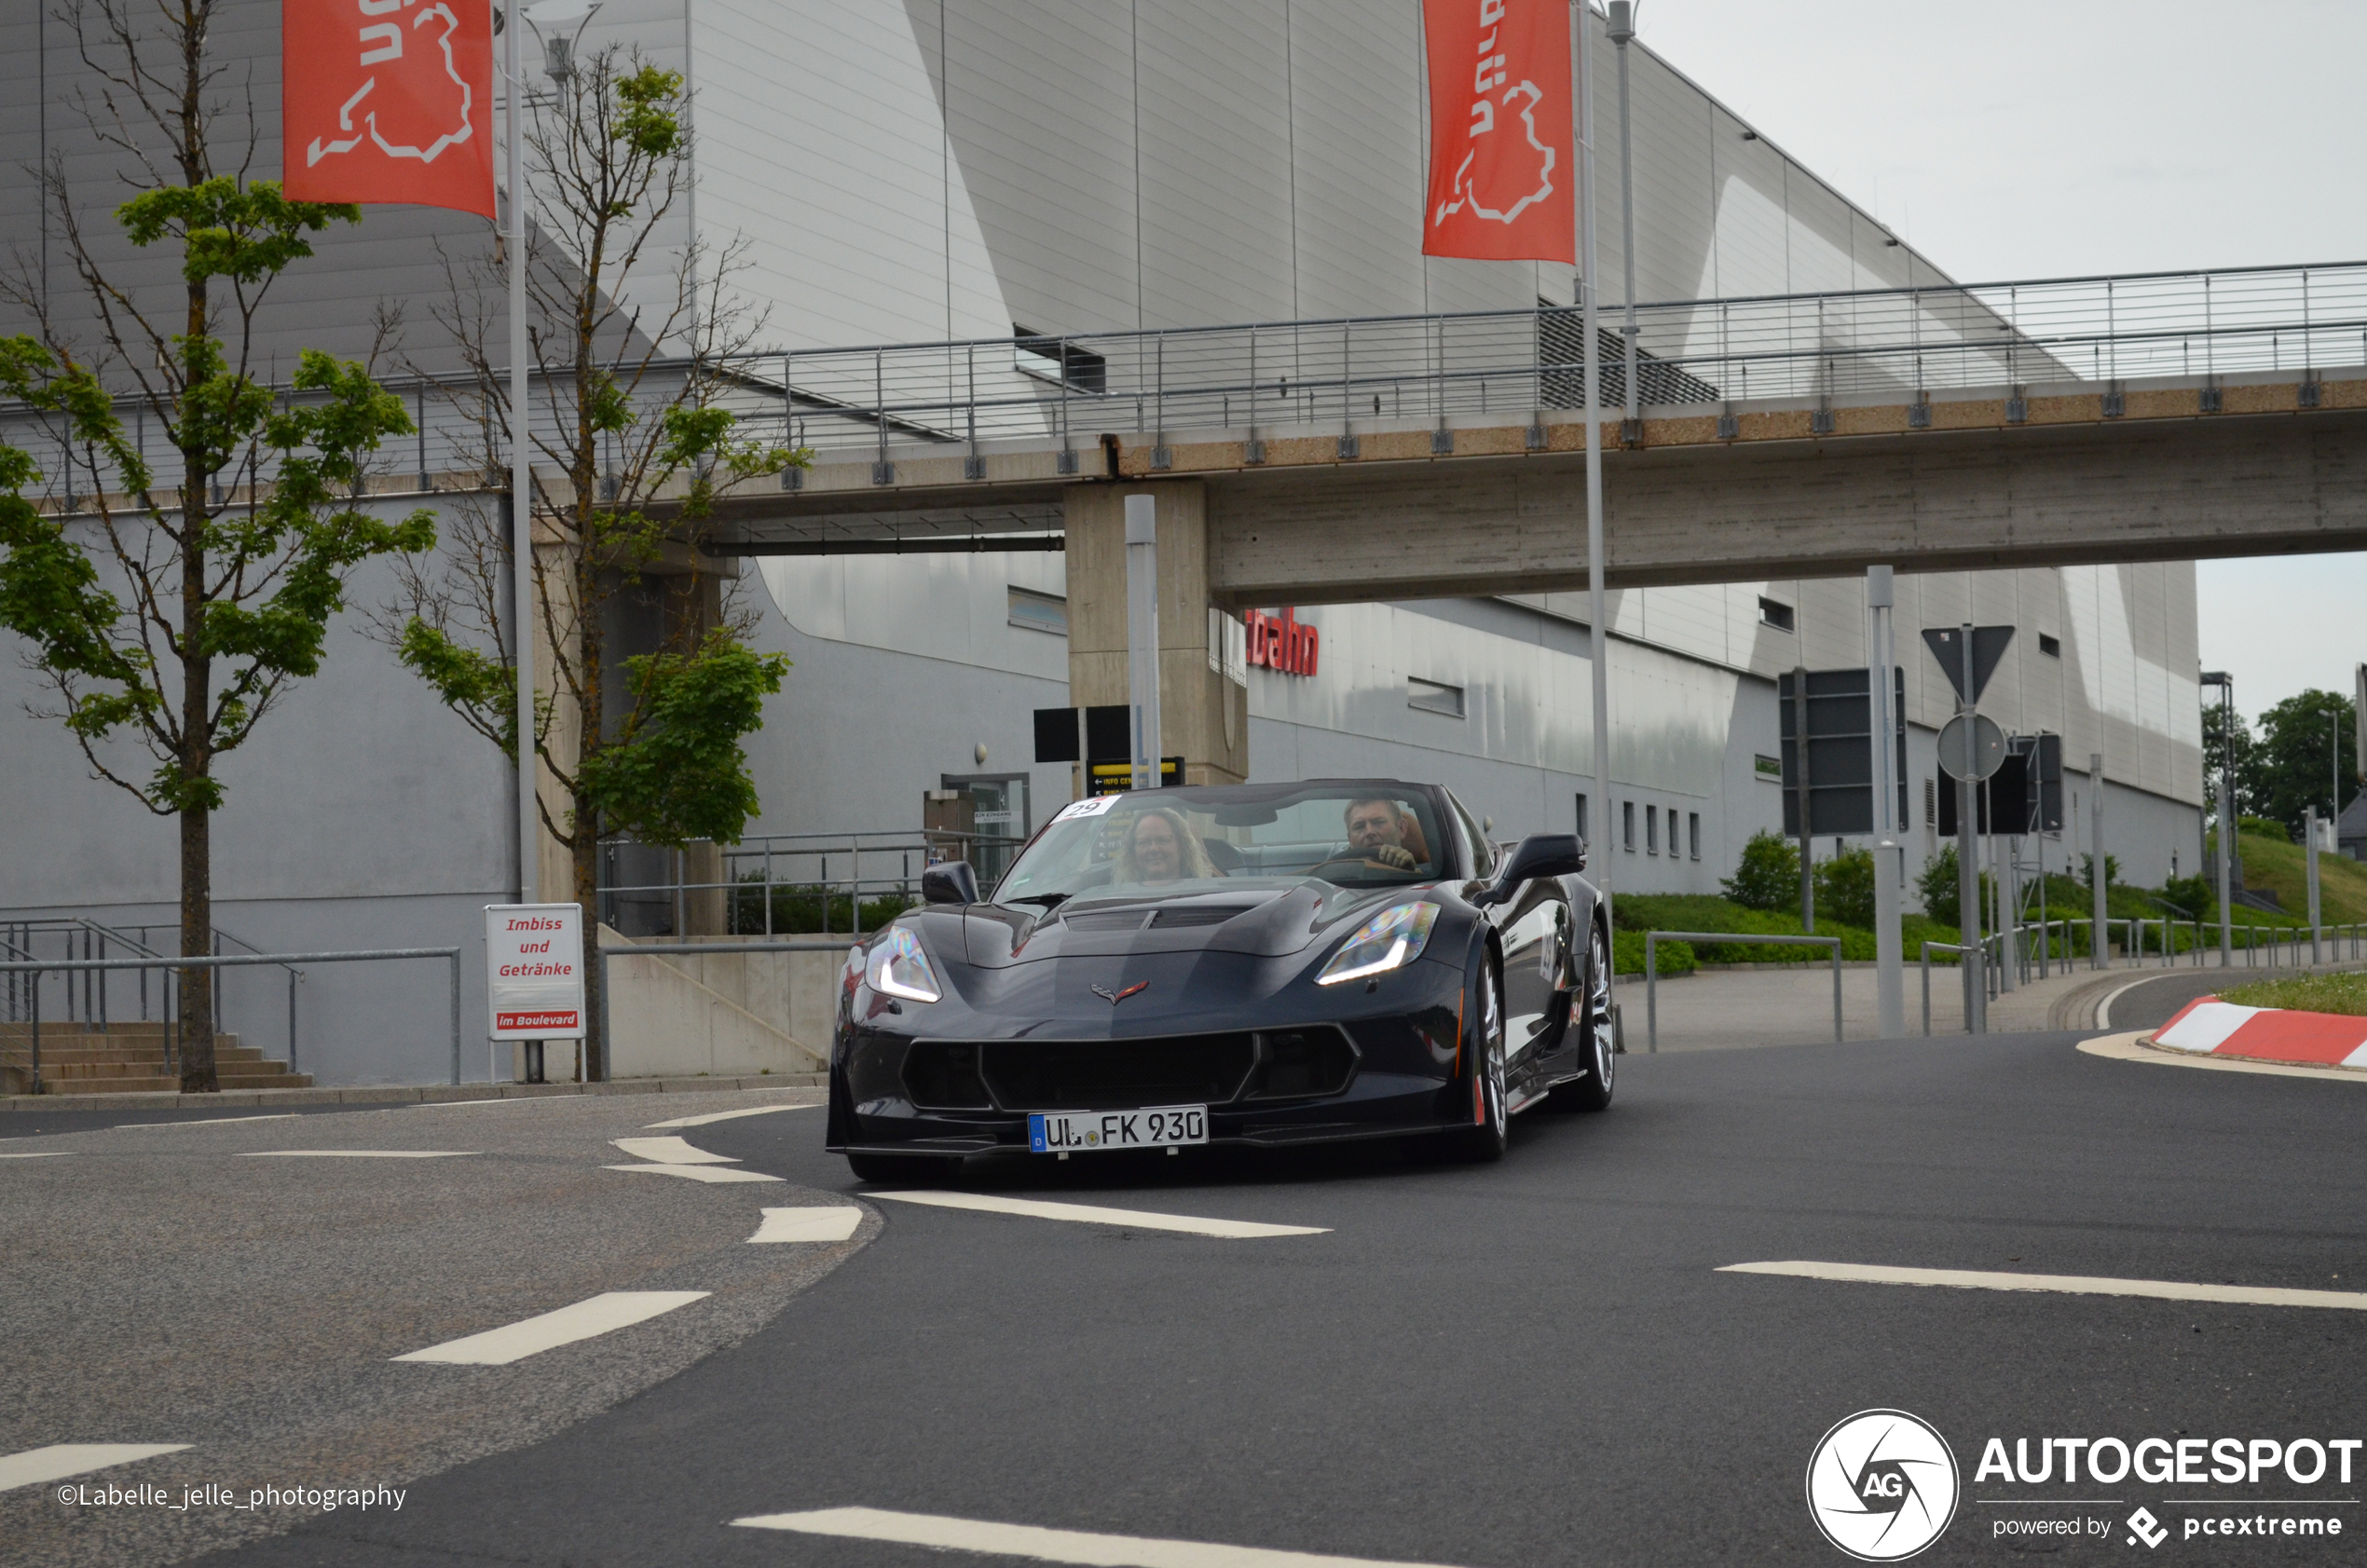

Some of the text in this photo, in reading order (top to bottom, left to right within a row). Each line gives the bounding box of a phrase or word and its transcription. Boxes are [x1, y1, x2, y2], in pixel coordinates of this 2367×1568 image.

[1064, 802, 1101, 817] 29
[506, 918, 563, 931] Imbiss
[520, 940, 550, 953] und
[499, 962, 571, 976] Getränke
[499, 1015, 575, 1026] im Boulevard
[1046, 1111, 1204, 1146] UL FK 930
[1035, 1137, 1042, 1146] D
